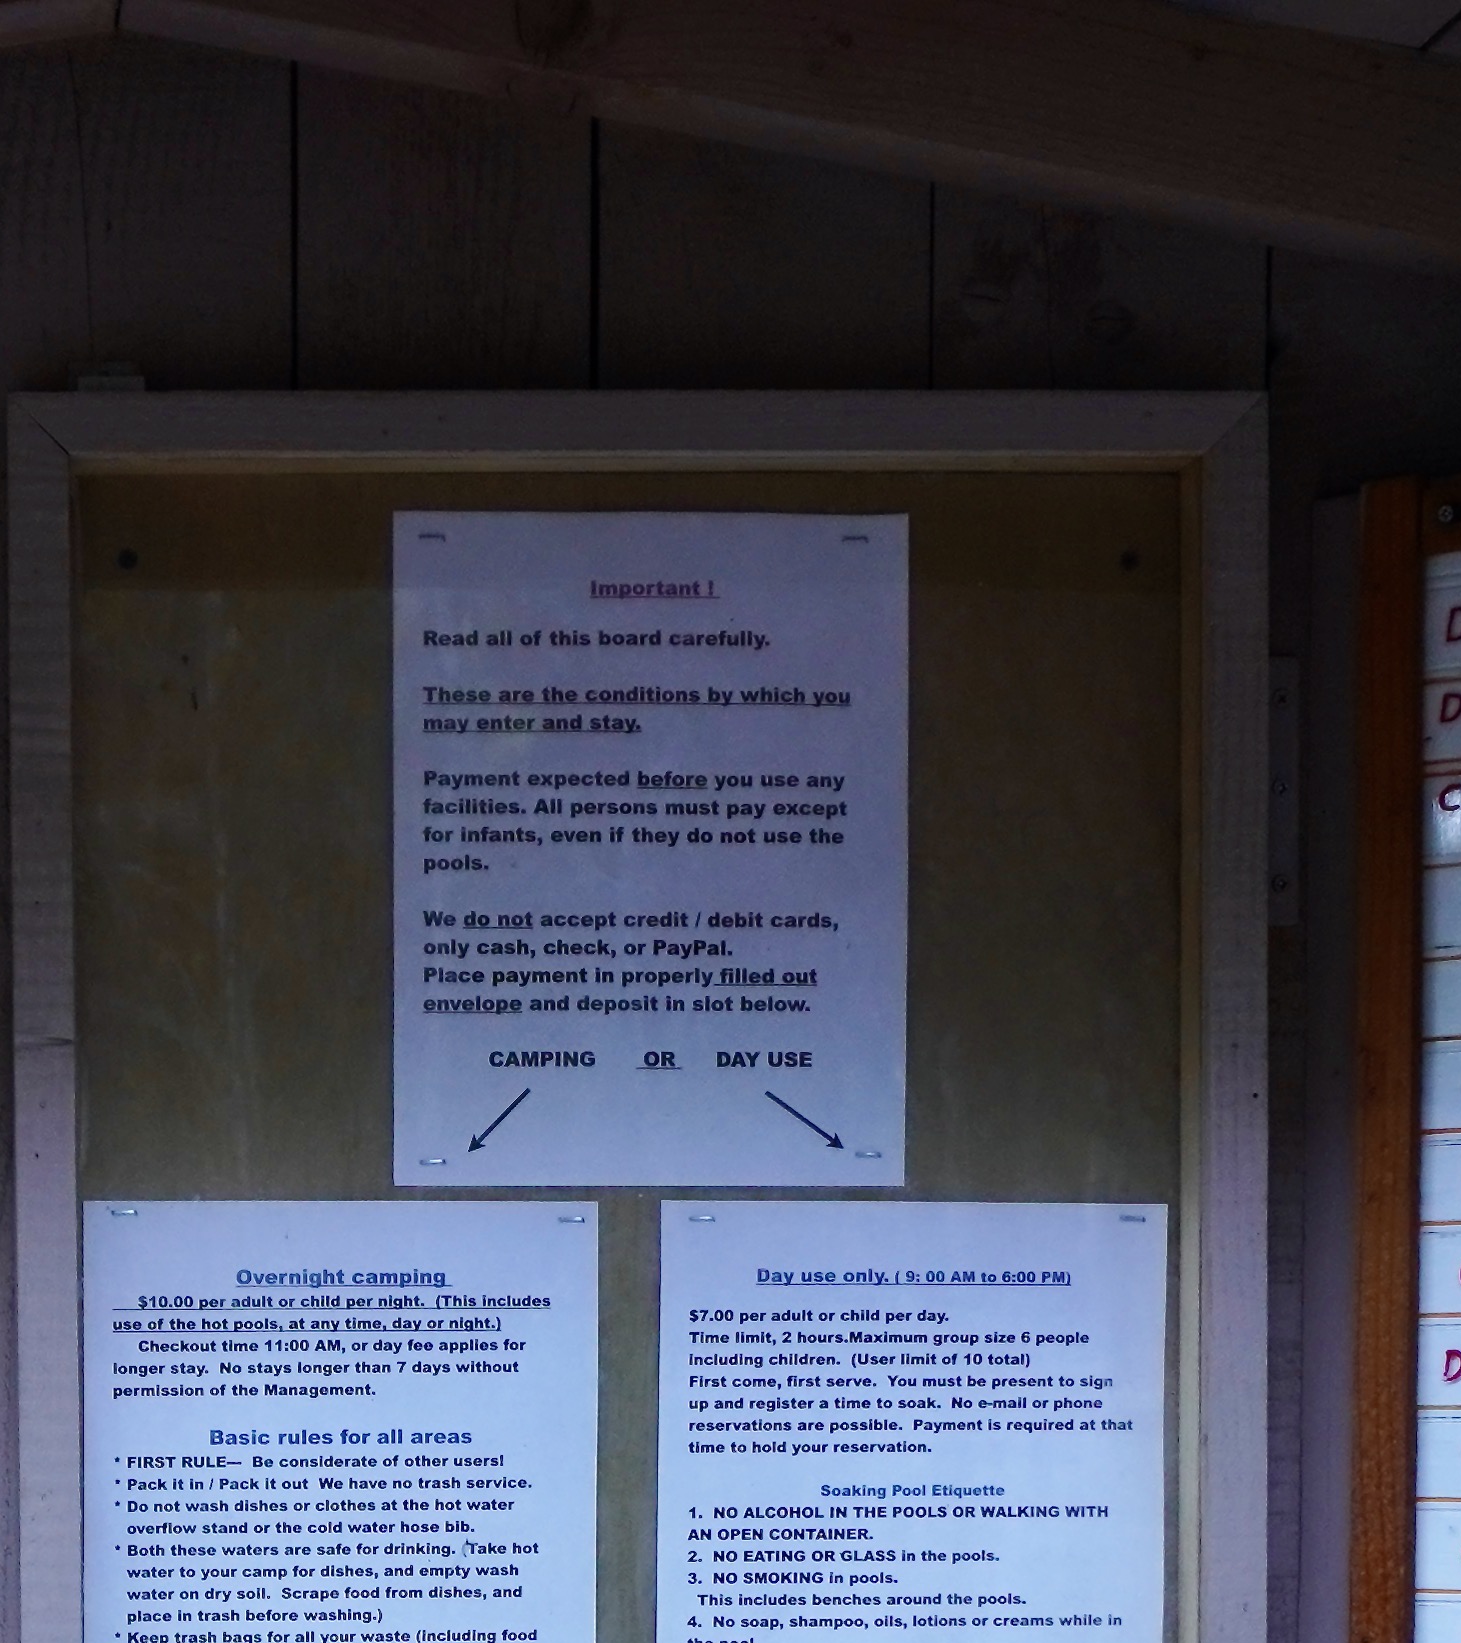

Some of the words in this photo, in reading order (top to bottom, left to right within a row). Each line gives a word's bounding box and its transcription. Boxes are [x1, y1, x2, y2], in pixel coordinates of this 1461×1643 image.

[589, 580, 704, 600] Important
[423, 629, 479, 647] Read
[485, 630, 513, 647] all
[519, 629, 542, 647] of
[549, 629, 591, 647] this
[598, 629, 662, 647] board
[667, 629, 772, 652] carefully.
[487, 1050, 597, 1069] CAMPING
[642, 1050, 677, 1068] OR
[716, 1050, 759, 1068] DAY
[766, 1050, 813, 1068] USE
[235, 1268, 345, 1289] Overnight
[351, 1269, 447, 1288] camping
[689, 1309, 734, 1323] $7.00
[739, 1312, 767, 1325] per
[770, 1309, 813, 1322] adult
[818, 1312, 836, 1322] or
[840, 1309, 880, 1322] child
[885, 1312, 913, 1325] per
[916, 1309, 949, 1325] day.
[209, 1429, 270, 1446] Basic
[278, 1429, 334, 1445] rules
[339, 1428, 371, 1445] for
[376, 1428, 403, 1445] all
[410, 1432, 472, 1445] areas
[820, 1484, 887, 1500] Soaking
[892, 1484, 926, 1497] Pool
[931, 1484, 1005, 1499] Etiquette
